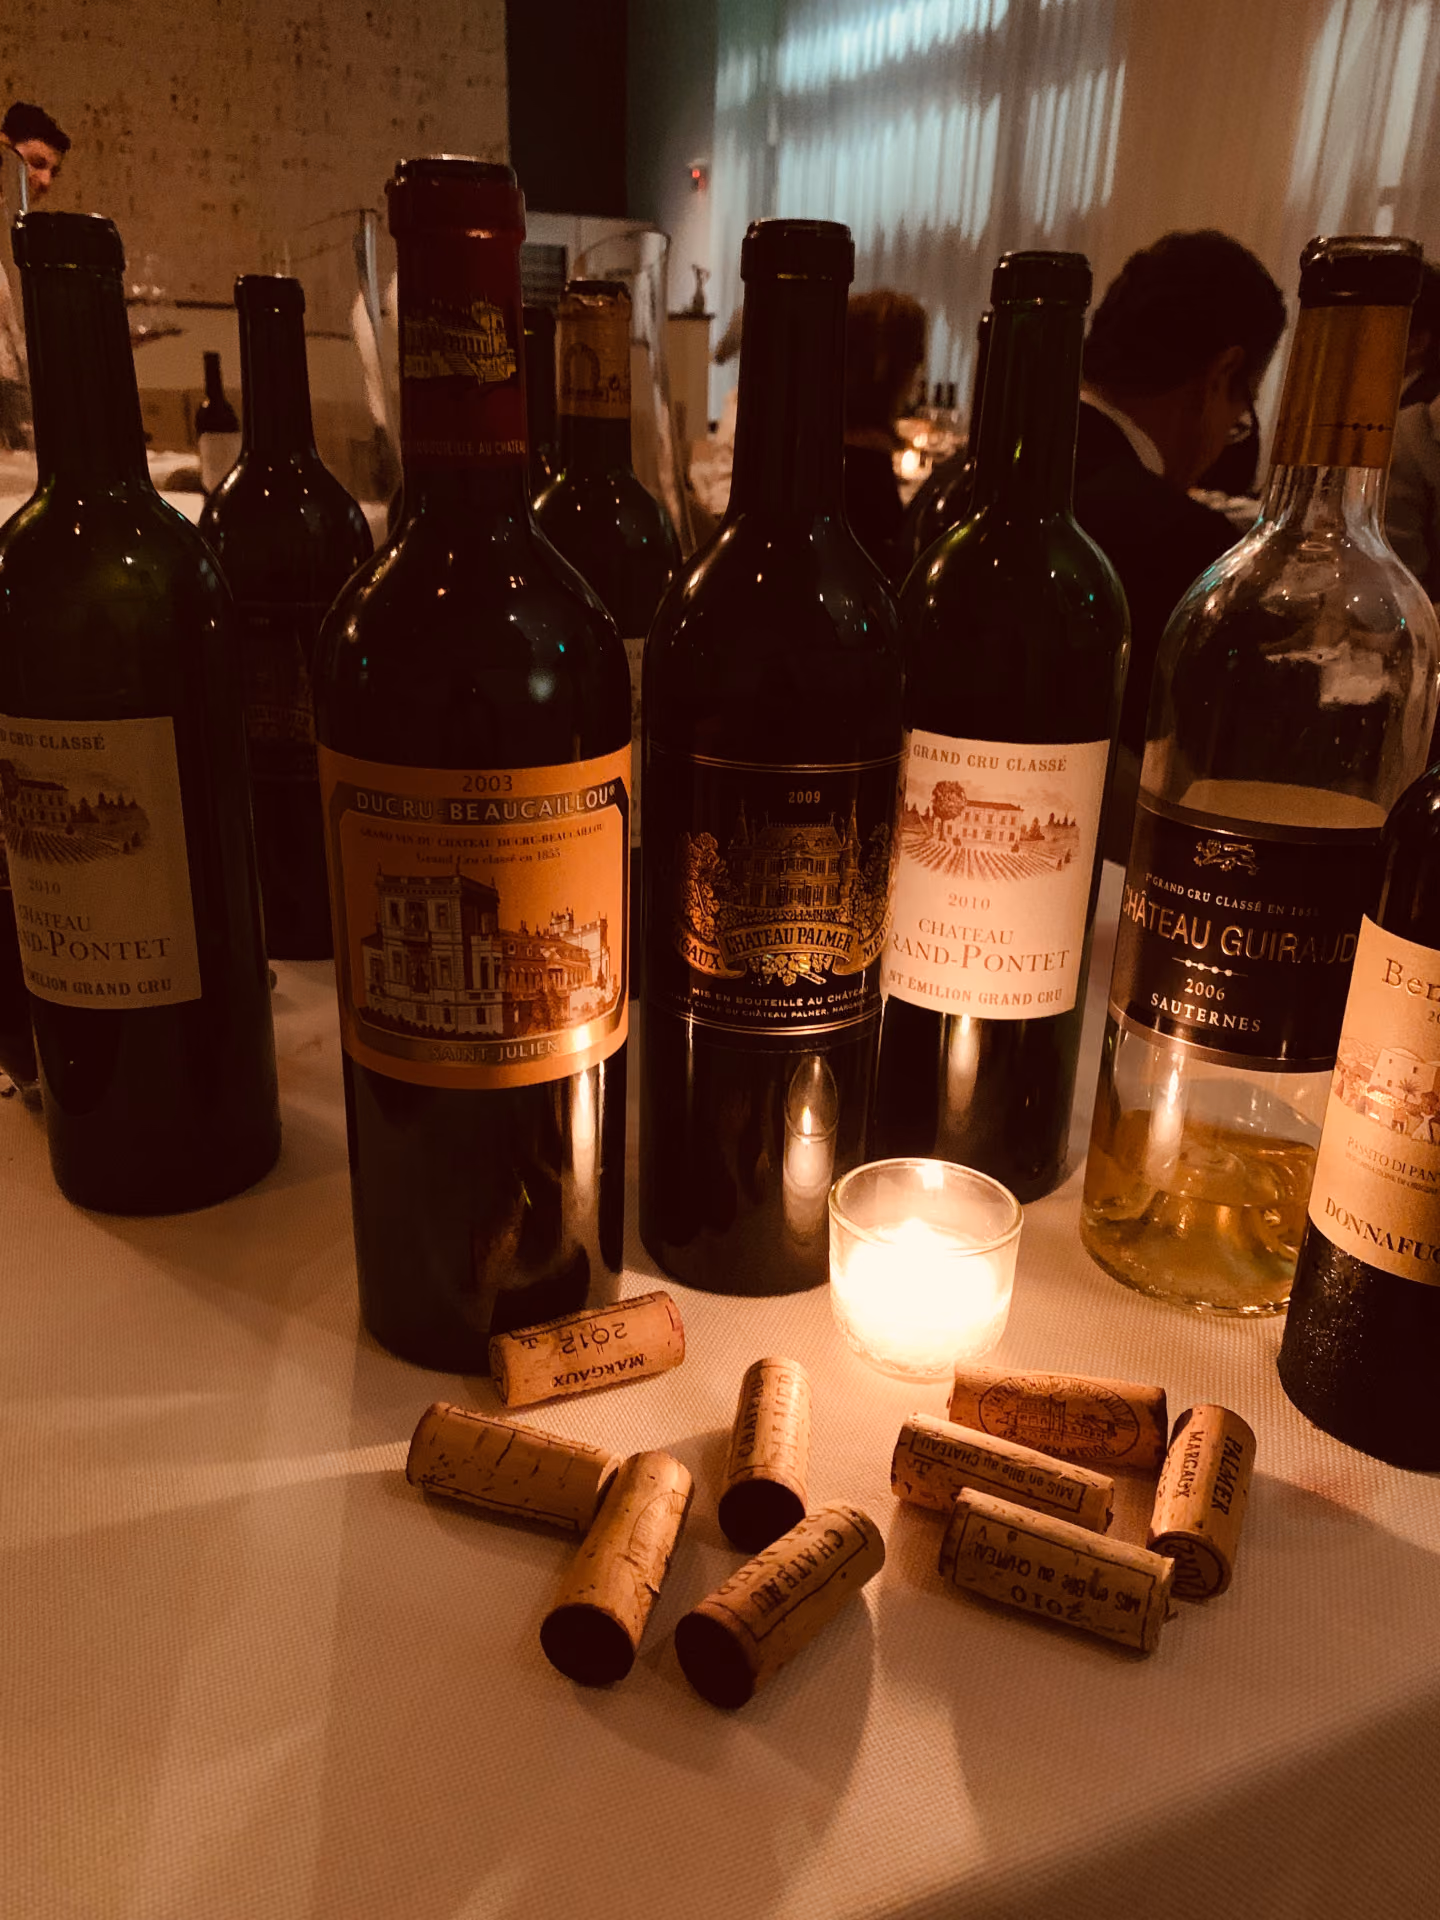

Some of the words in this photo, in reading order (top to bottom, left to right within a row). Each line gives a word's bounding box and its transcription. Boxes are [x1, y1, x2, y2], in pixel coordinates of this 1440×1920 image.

[10, 731, 33, 747] CRU
[39, 732, 105, 750] CLASSÉ
[913, 744, 961, 766] GRAND
[967, 754, 1000, 770] CRU
[1006, 755, 1067, 772] CLASSÉ
[463, 775, 513, 793] 2003
[789, 790, 822, 805] 2009
[29, 880, 61, 895] 2010
[1152, 876, 1184, 896] GRAND
[1187, 888, 1211, 903] CRU
[1215, 894, 1262, 913] CLASSÉ
[1267, 903, 1285, 915] EN
[948, 891, 990, 911] 2010
[918, 918, 1014, 945] CHATEAU
[1122, 883, 1212, 950] CHÂTEAU
[1220, 924, 1358, 964] GUIRAUD
[797, 926, 854, 953] PALMER
[72, 979, 131, 996] GRAND
[138, 978, 172, 993] CRU
[692, 987, 711, 998] MIS
[716, 992, 731, 1002] EN
[736, 995, 804, 1007] BOUTEILLE
[807, 996, 823, 1006] AU
[978, 991, 1032, 1006] GRAND
[1038, 987, 1063, 1004] CRU
[1184, 977, 1225, 1001] 2006
[1150, 992, 1261, 1033] SAUTERNES
[433, 1045, 488, 1061] SAINT
[497, 1039, 558, 1062] JULIEN
[1392, 1160, 1406, 1174] DI
[560, 1322, 628, 1355] 2012
[553, 1353, 645, 1388] MARGAUX
[920, 1438, 979, 1464] CHATEAU
[984, 1457, 1001, 1469] au
[1177, 1431, 1204, 1498] MARGAUX
[1211, 1436, 1243, 1515] PALMER
[1029, 1474, 1044, 1486] en
[1047, 1481, 1074, 1500] MIS
[751, 1528, 844, 1615] CHATEAU
[1038, 1565, 1056, 1582] au
[1010, 1585, 1083, 1621] 2010
[1115, 1591, 1141, 1615] MIS
